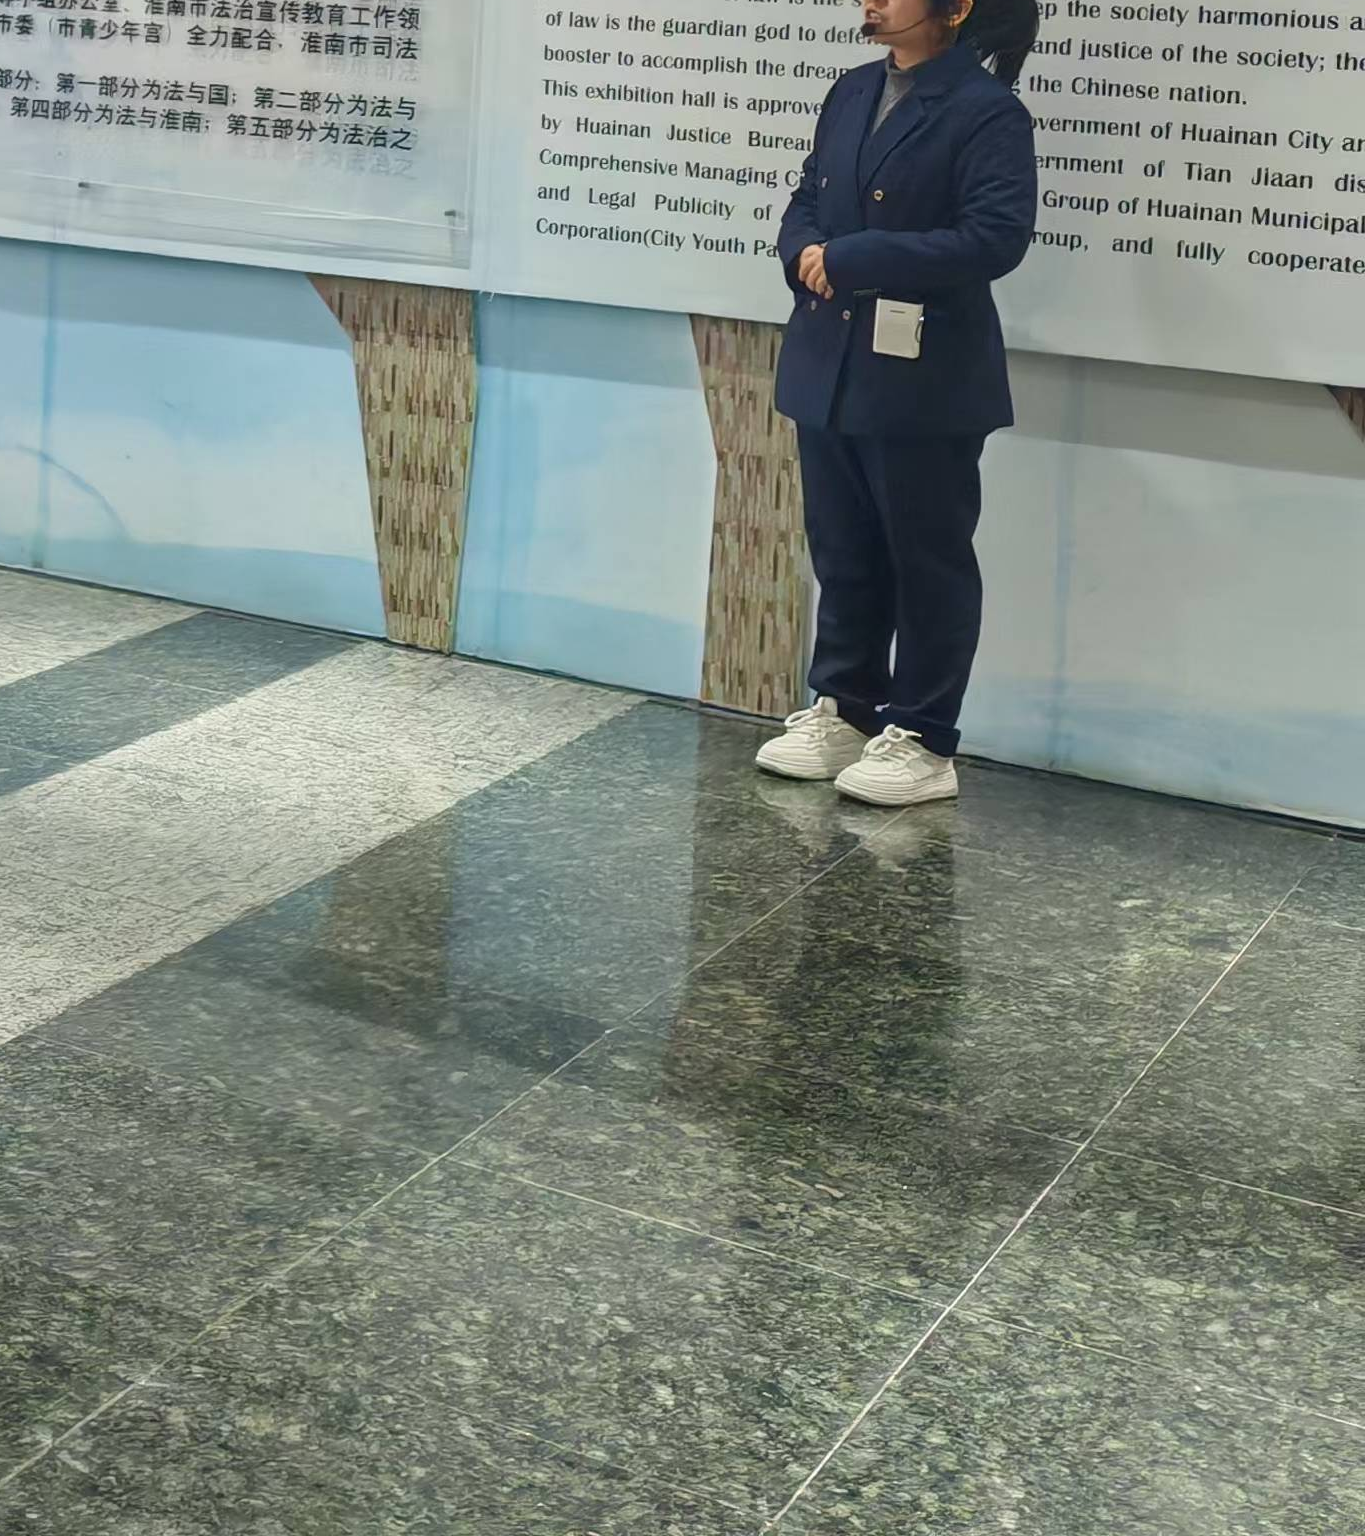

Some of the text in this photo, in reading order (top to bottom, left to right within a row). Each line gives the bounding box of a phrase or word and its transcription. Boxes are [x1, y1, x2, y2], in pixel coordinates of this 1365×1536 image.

[545, 10, 817, 44] of law is the guardian god to
[543, 44, 786, 78] booster to accomplish the
[1031, 37, 1073, 56] and
[1078, 38, 1153, 61] justice
[1161, 43, 1185, 63] of
[1192, 44, 1228, 65] the
[1236, 48, 1325, 74] society;
[1029, 73, 1248, 106] the Chinese nation.
[538, 148, 778, 190] Comprehensive Managing
[536, 184, 774, 221] and Legal Publicity of
[1042, 189, 1110, 216] Group
[1117, 196, 1140, 215] of
[1146, 198, 1243, 225] Huainan
[1111, 236, 1154, 256] and
[1176, 239, 1226, 266] fully
